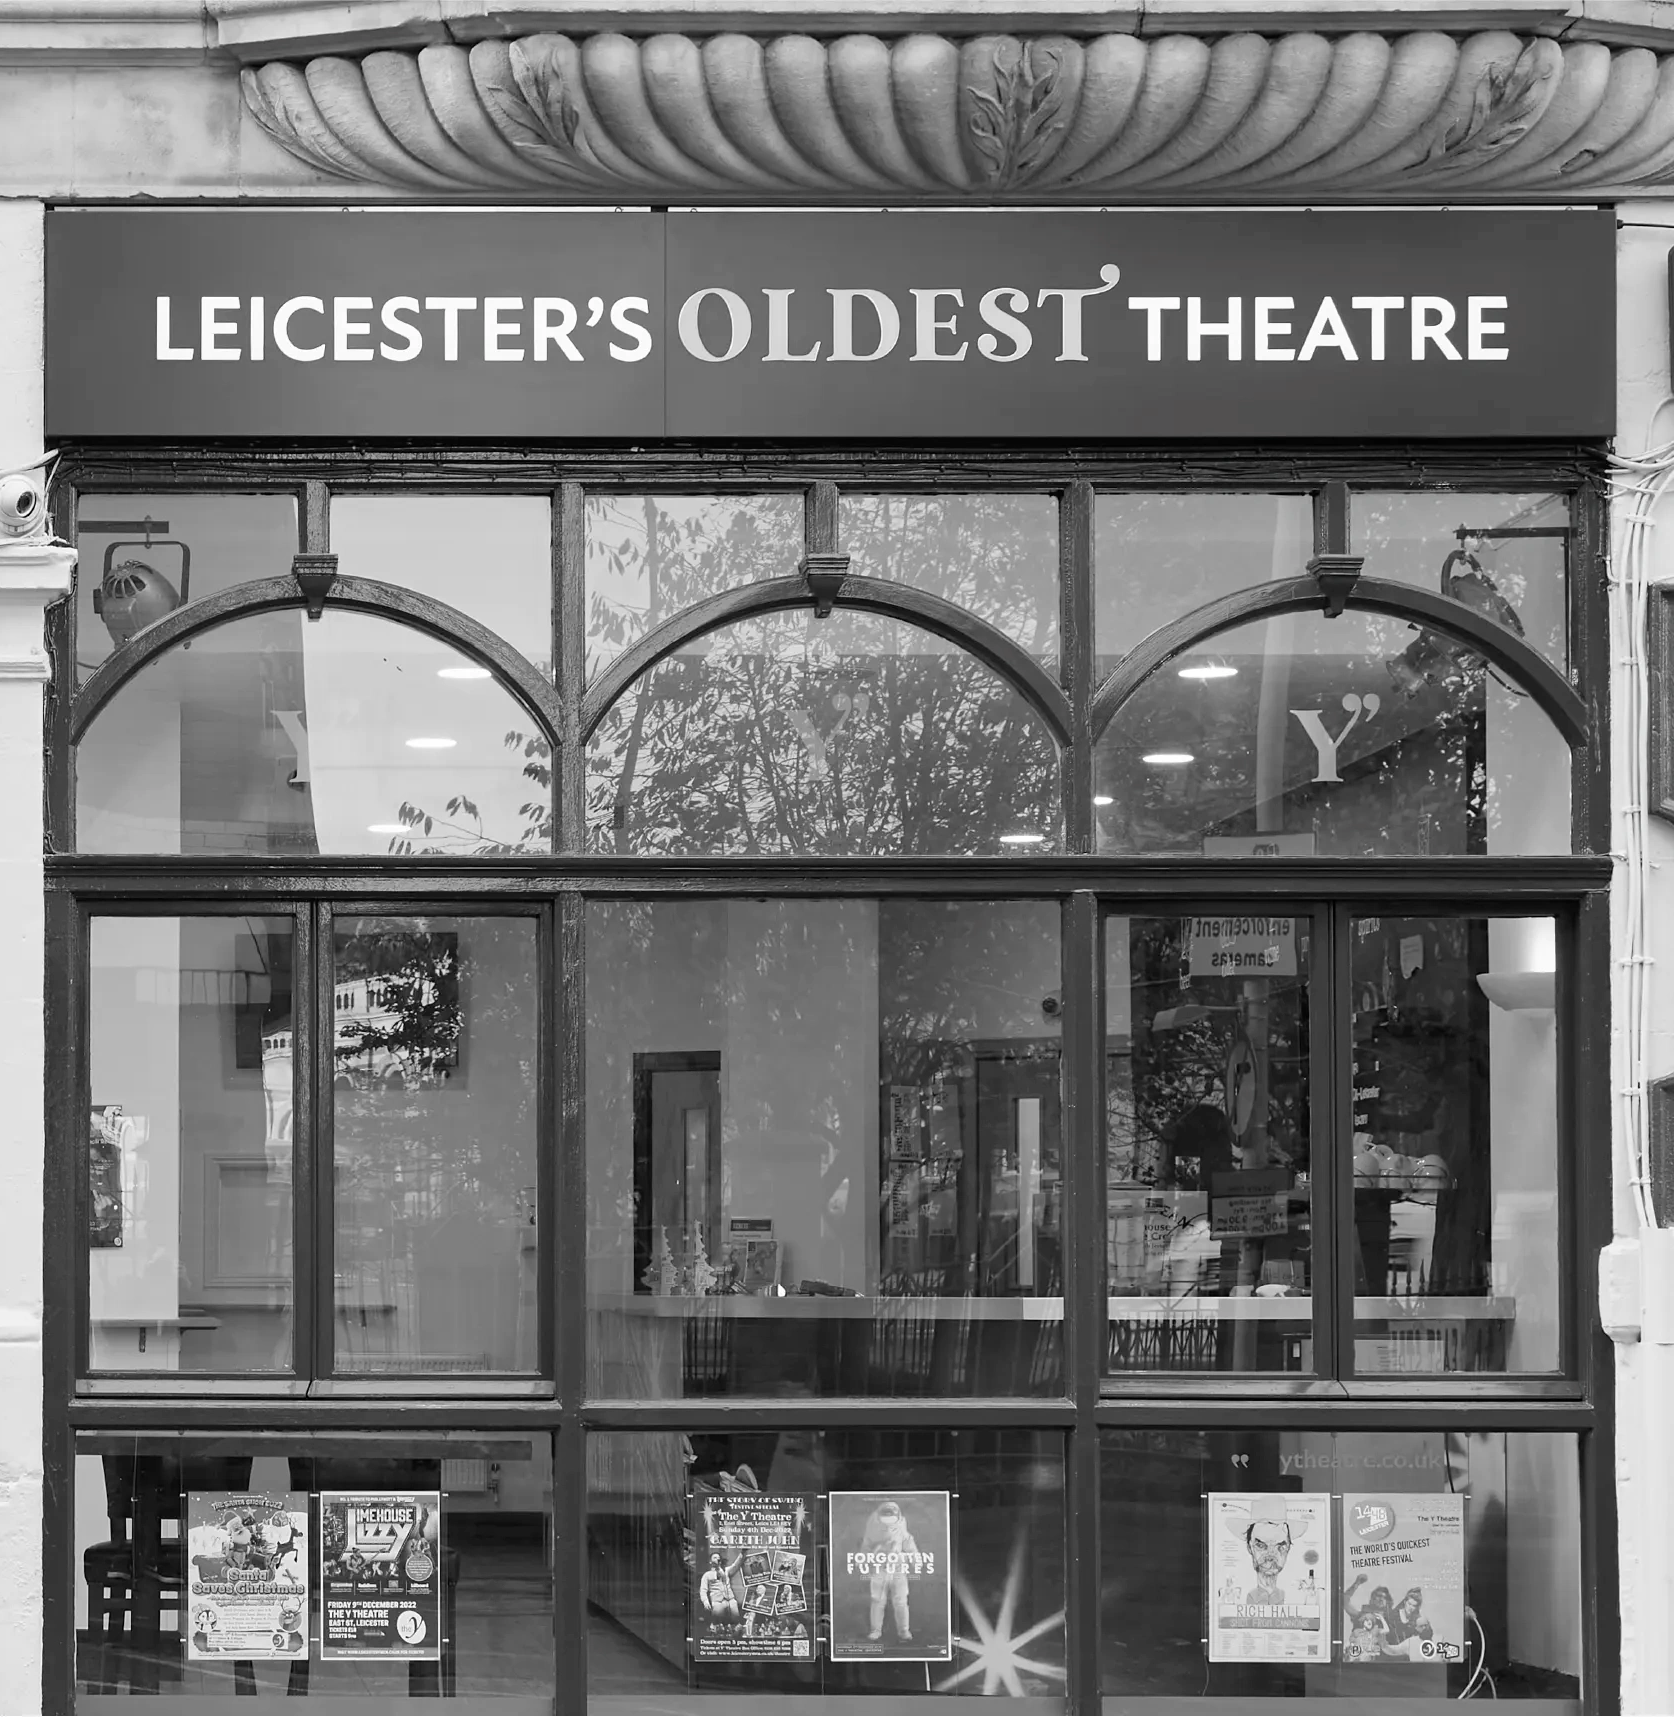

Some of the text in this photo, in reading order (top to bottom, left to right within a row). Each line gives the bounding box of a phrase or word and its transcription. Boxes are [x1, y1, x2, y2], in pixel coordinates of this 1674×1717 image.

[156, 263, 1510, 362] LEICESTER’S OLDEST THEATRE
[718, 1509, 792, 1521] The Y Theatre
[709, 1535, 800, 1545] GARETH JOHN
[1349, 1546, 1363, 1556] THE
[1397, 1538, 1431, 1550] QUICKEST
[846, 1552, 935, 1564] FORGOTTEN
[1351, 1553, 1414, 1569] THEATRE FESTIVAL
[846, 1563, 935, 1574] FUTURES
[227, 1568, 268, 1582] Santa
[192, 1582, 305, 1595] Saves Christmas
[328, 1601, 352, 1609] FRIDAY
[362, 1601, 399, 1609] DECEMBER
[399, 1601, 417, 1609] 2022
[328, 1609, 389, 1618] THE Y THEATRE
[1236, 1605, 1302, 1618] RICH HALL
[329, 1619, 345, 1627] EAST
[356, 1619, 389, 1627] LEICESTER
